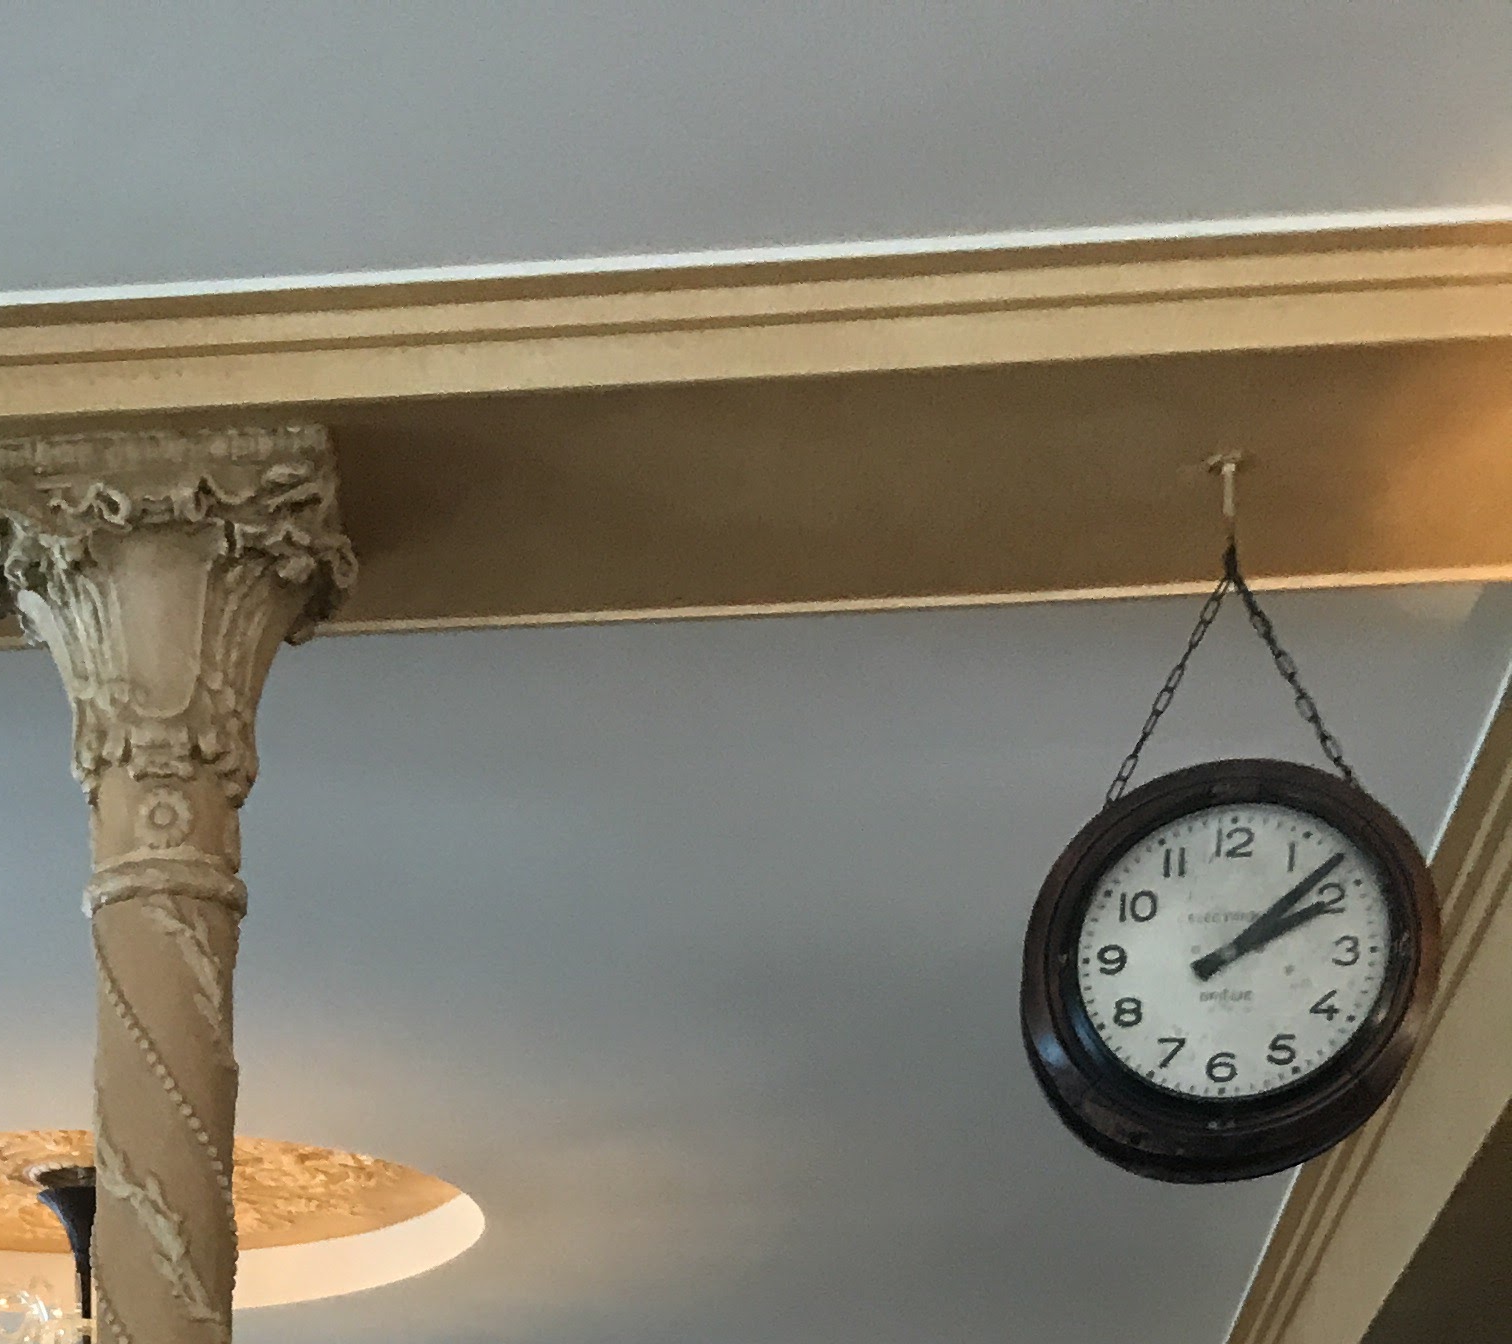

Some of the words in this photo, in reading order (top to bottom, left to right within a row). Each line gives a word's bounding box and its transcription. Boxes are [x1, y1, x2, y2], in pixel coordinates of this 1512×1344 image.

[1215, 826, 1255, 858] 12
[1288, 842, 1296, 872] 1
[1162, 847, 1186, 878] 11
[1119, 889, 1159, 923] 10
[1317, 882, 1346, 914] 2
[1097, 944, 1128, 976] 9
[1331, 935, 1361, 966] 3
[1113, 996, 1144, 1028] 8
[1310, 989, 1340, 1020] 4
[1157, 1036, 1187, 1068] 7
[1267, 1033, 1297, 1065] 5
[1205, 1051, 1238, 1082] 6
